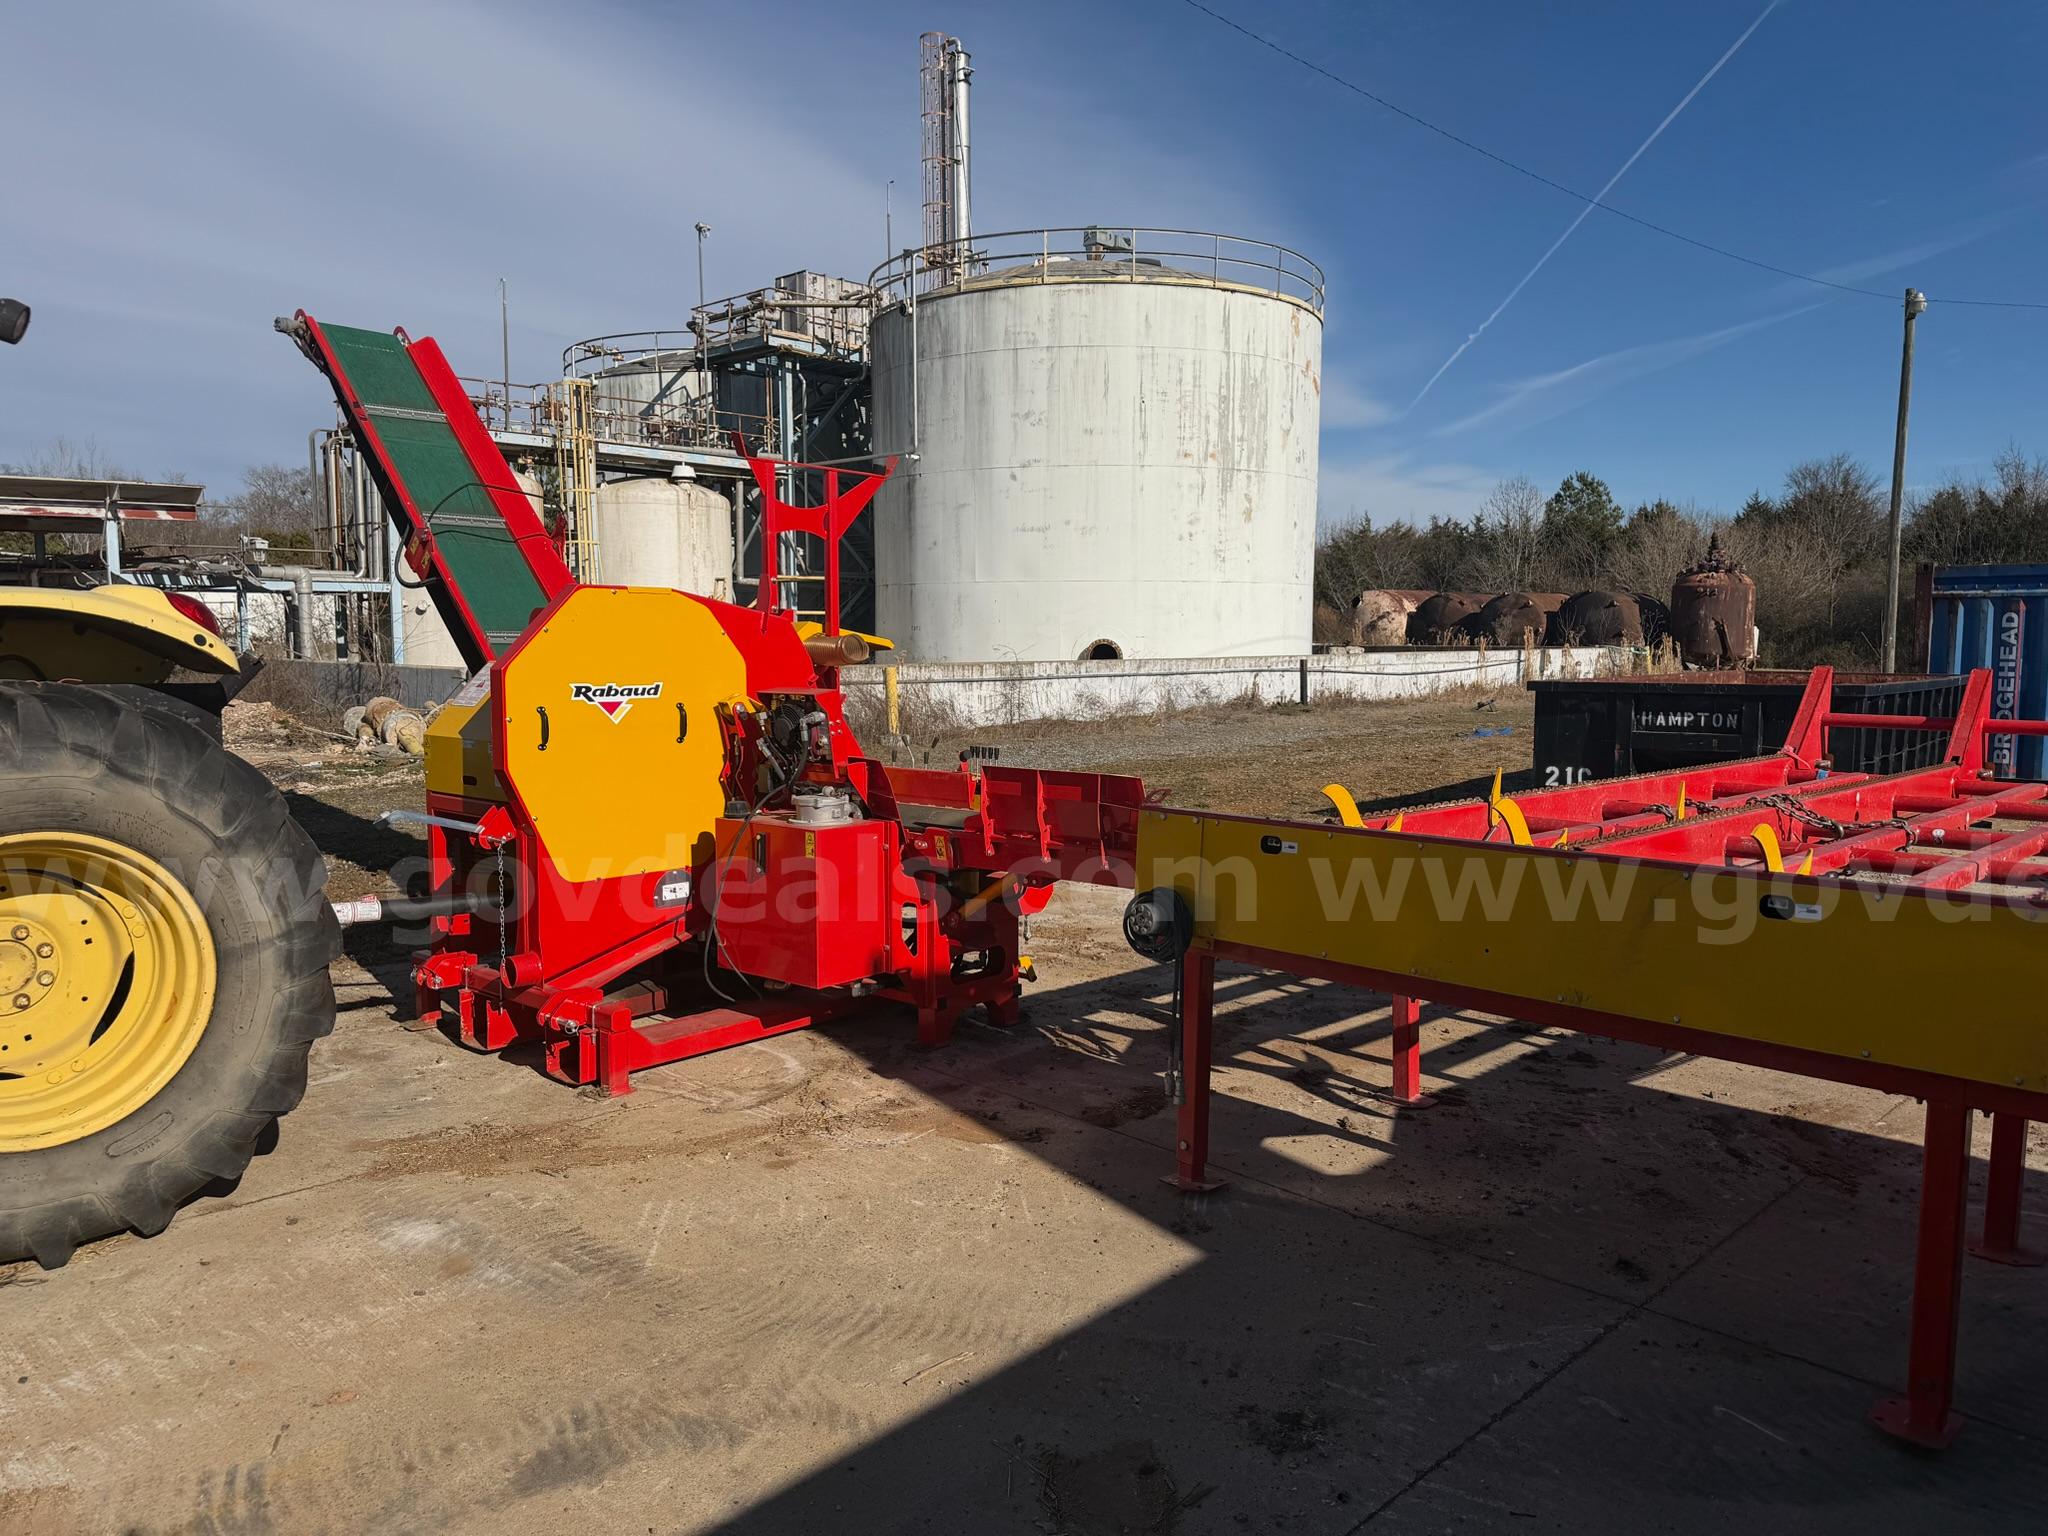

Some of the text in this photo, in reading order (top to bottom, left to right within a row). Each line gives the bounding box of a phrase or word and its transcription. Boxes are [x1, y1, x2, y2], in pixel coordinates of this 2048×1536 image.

[573, 684, 661, 702] Rabaud
[1993, 611, 2020, 764] BRDGEHEAD
[1641, 711, 1738, 729] HAMPTON
